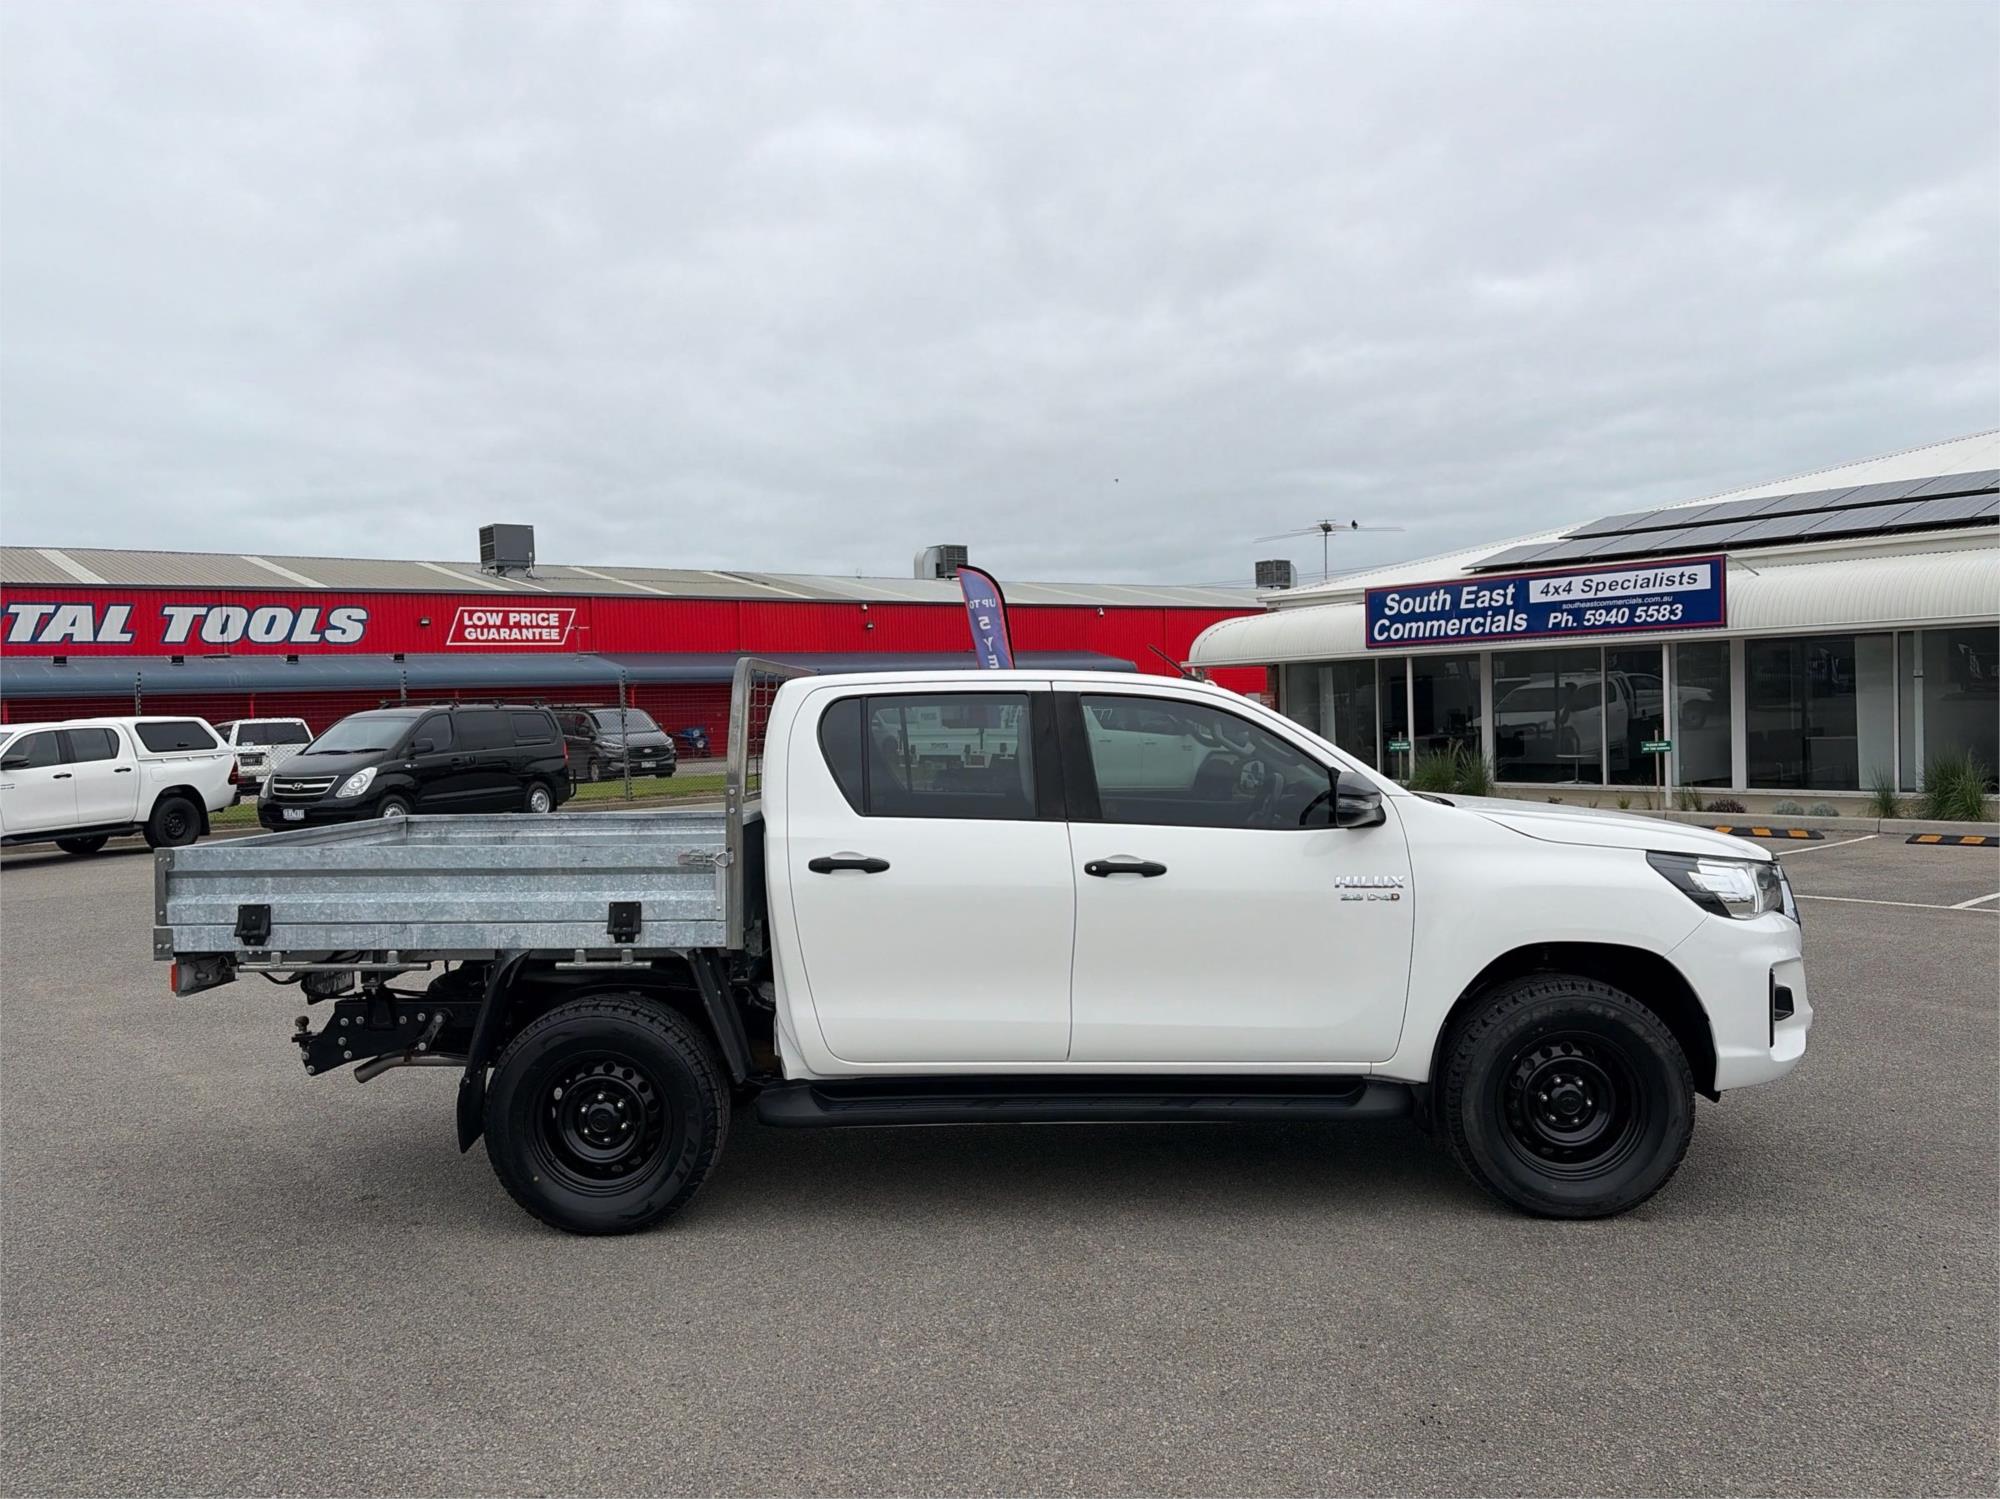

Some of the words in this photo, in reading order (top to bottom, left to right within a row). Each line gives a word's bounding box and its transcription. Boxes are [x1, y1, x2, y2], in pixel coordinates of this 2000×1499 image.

[1540, 582, 1573, 597] 4x4
[1580, 570, 1699, 596] Specialists
[1384, 591, 1452, 616] South
[1459, 584, 1516, 609] East
[1561, 595, 1674, 610] southeastcommercials.com.au
[6, 604, 134, 643] TAL
[162, 607, 368, 644] TOOLS
[464, 612, 503, 625] LOW
[509, 612, 559, 626] PRICE
[1373, 609, 1528, 642] Commercials
[1548, 611, 1578, 629] Ph.
[1583, 607, 1630, 627] 5940
[1634, 603, 1683, 623] 5583
[464, 627, 560, 640] GUARANTEE
[1334, 875, 1404, 889] HILUX
